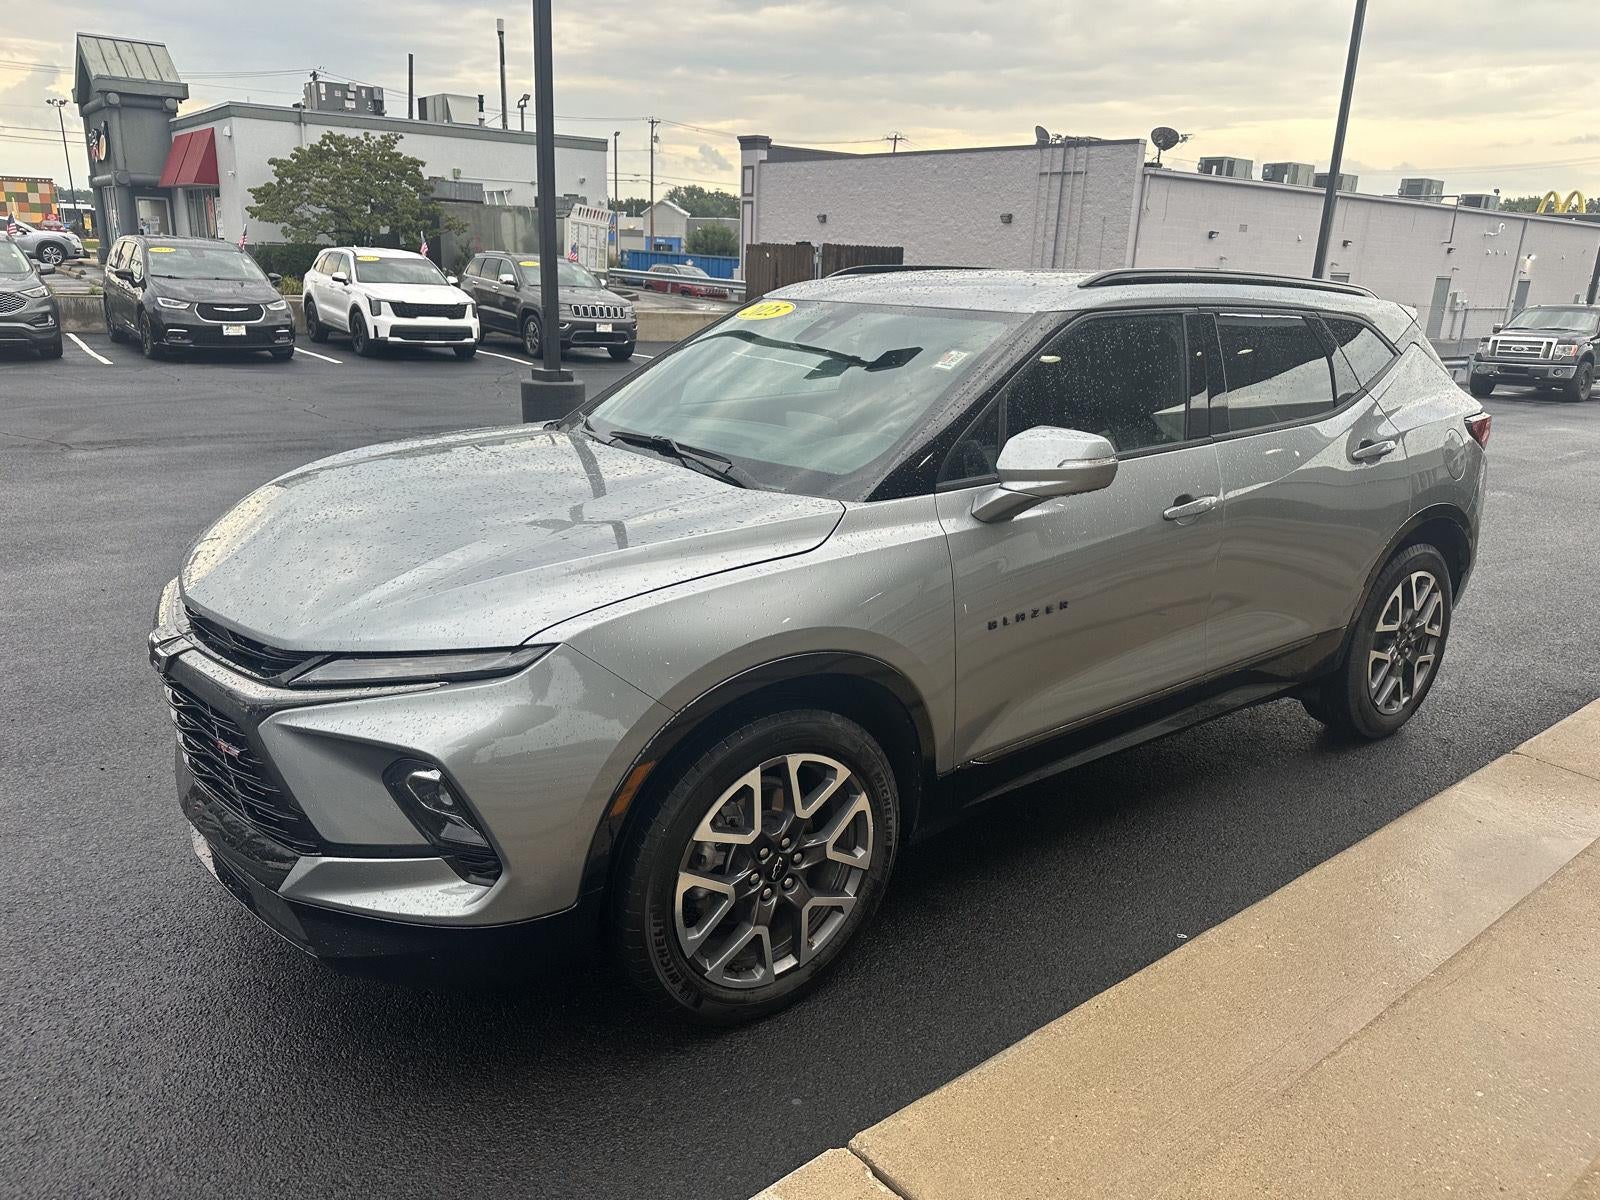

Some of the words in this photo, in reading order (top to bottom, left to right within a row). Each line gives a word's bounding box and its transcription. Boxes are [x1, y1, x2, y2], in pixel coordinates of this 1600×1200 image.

[987, 601, 1068, 630] BLAZER
[874, 772, 894, 846] MICHELIN
[651, 904, 684, 986] MICHELIN
